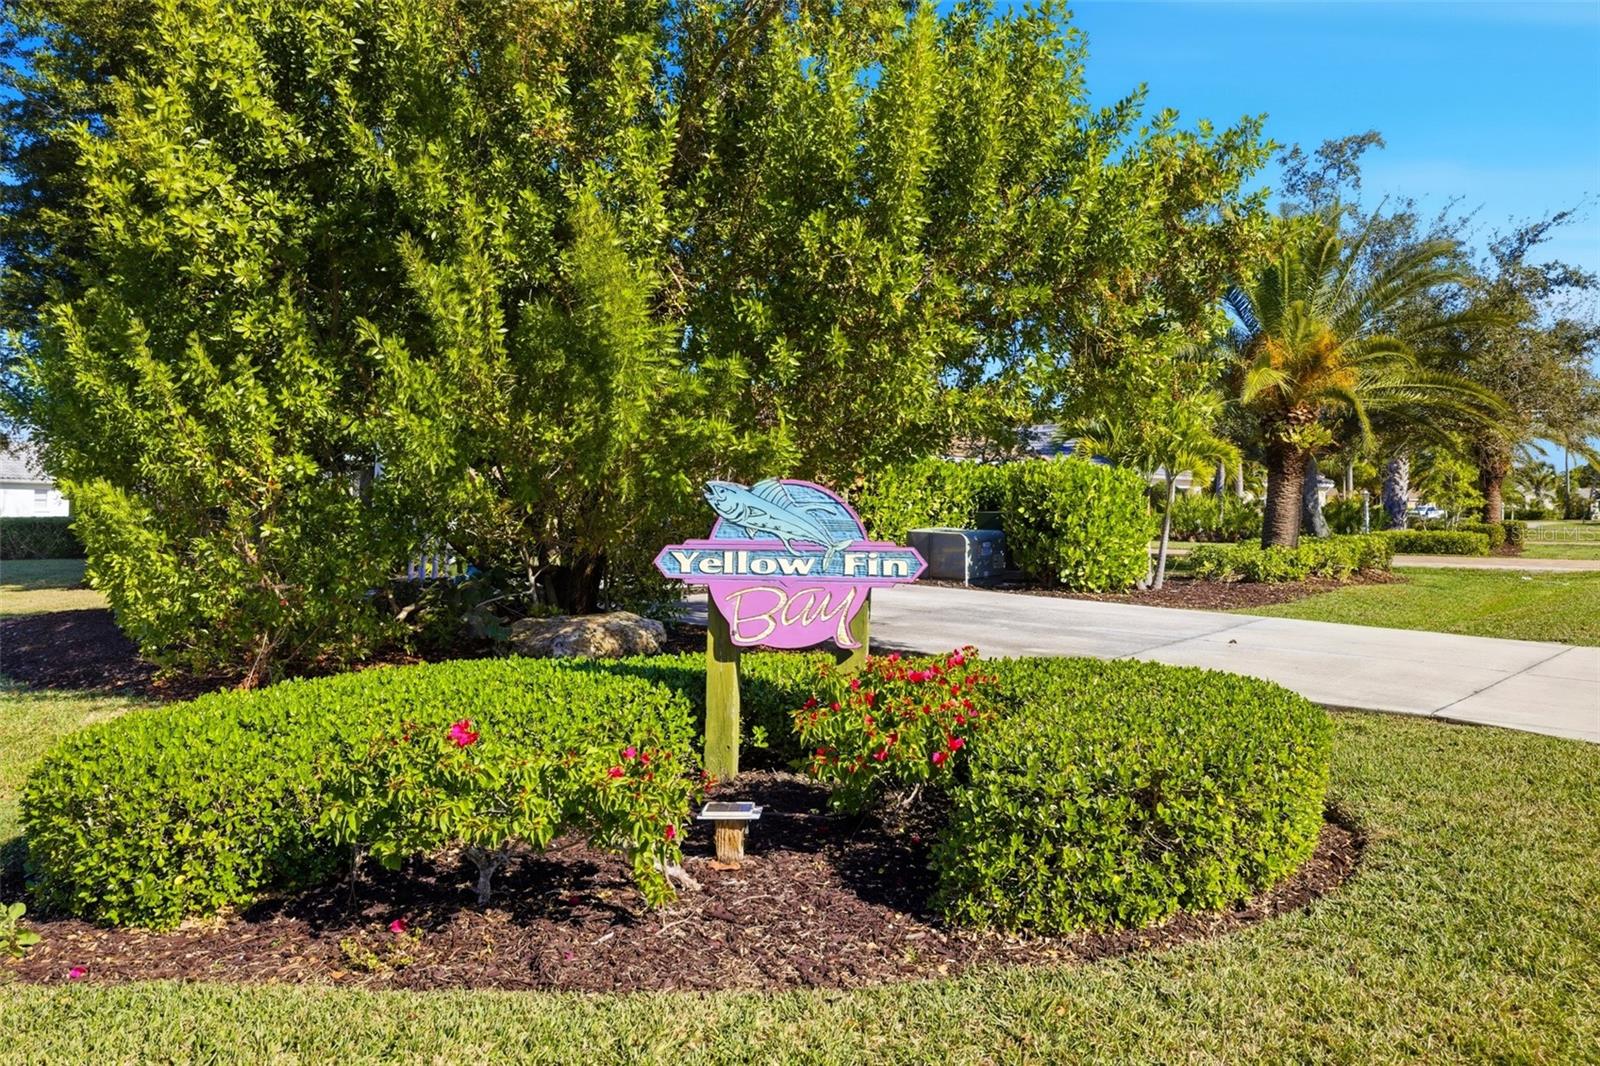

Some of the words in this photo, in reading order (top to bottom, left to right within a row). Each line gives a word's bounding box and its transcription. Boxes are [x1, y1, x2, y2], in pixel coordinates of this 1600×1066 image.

[670, 551, 815, 576] Yellow
[843, 551, 908, 577] Fin
[725, 586, 856, 646] Bay
